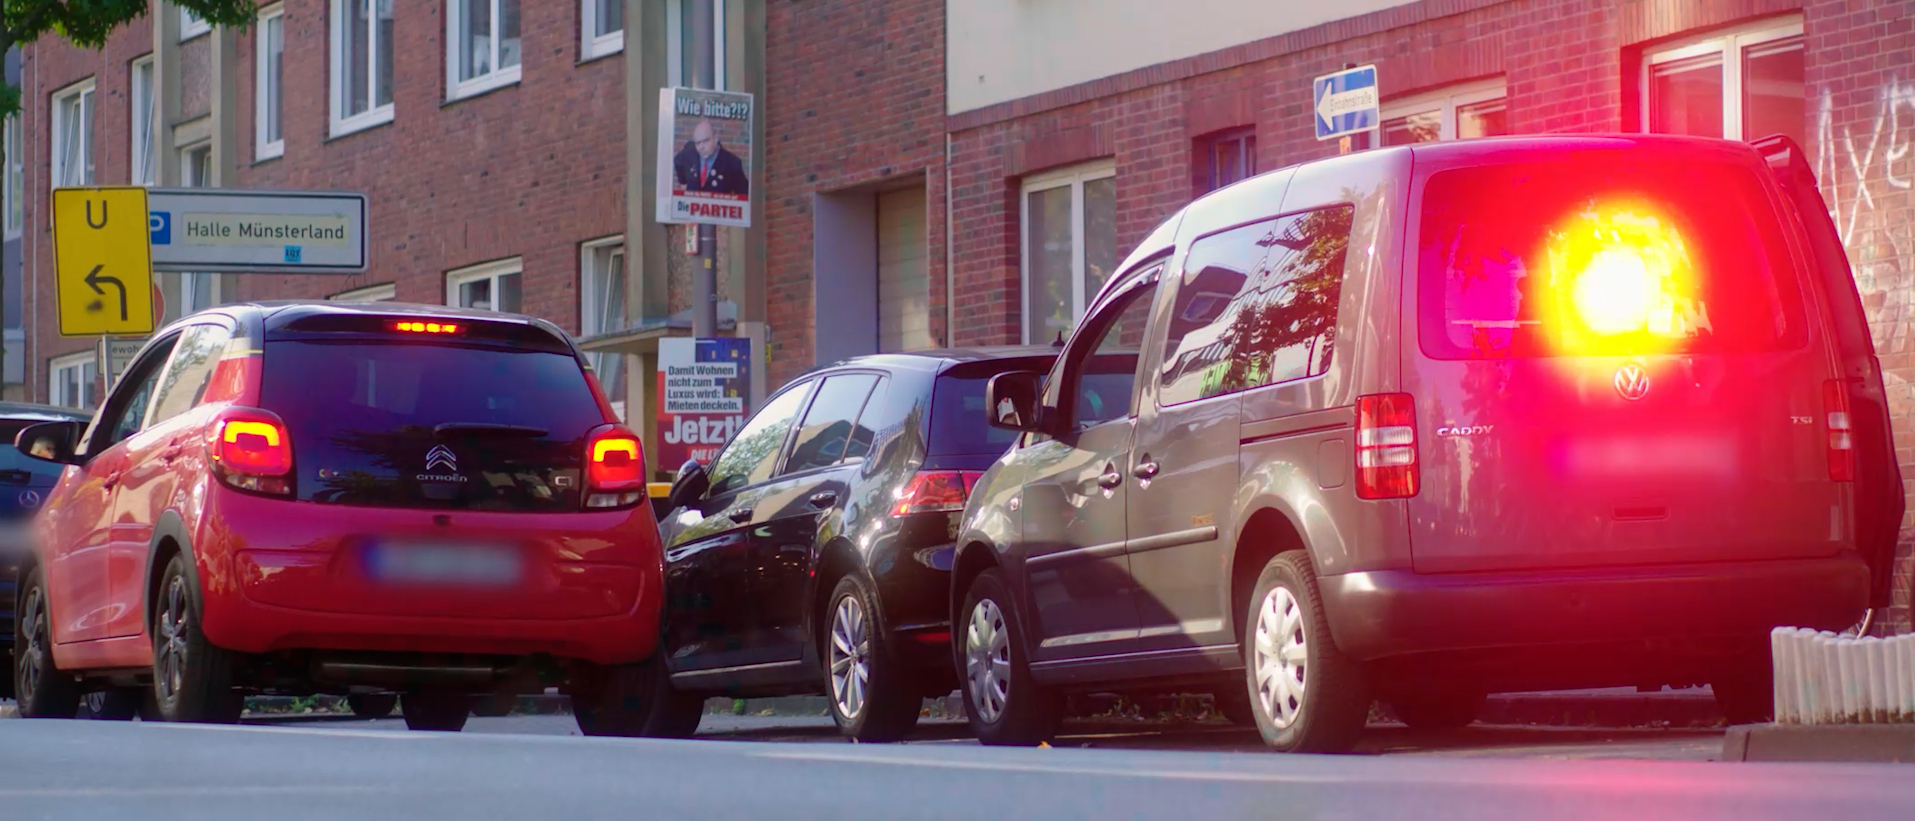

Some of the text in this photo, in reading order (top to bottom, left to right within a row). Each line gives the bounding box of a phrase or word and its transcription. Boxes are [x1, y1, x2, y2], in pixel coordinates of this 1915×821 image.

[677, 97, 749, 119] Wie bitte?!?
[85, 199, 107, 229] U
[677, 200, 743, 219] Die PARTEI
[187, 221, 231, 238] Halle
[239, 220, 345, 240] Münsterland
[668, 365, 734, 376] Damit Wohnen
[668, 377, 712, 387] nicht zum
[668, 389, 721, 399] Luxus wird:
[668, 400, 740, 411] Mieten deckeln.
[1436, 424, 1495, 436] CADDY
[691, 448, 707, 460] DIE
